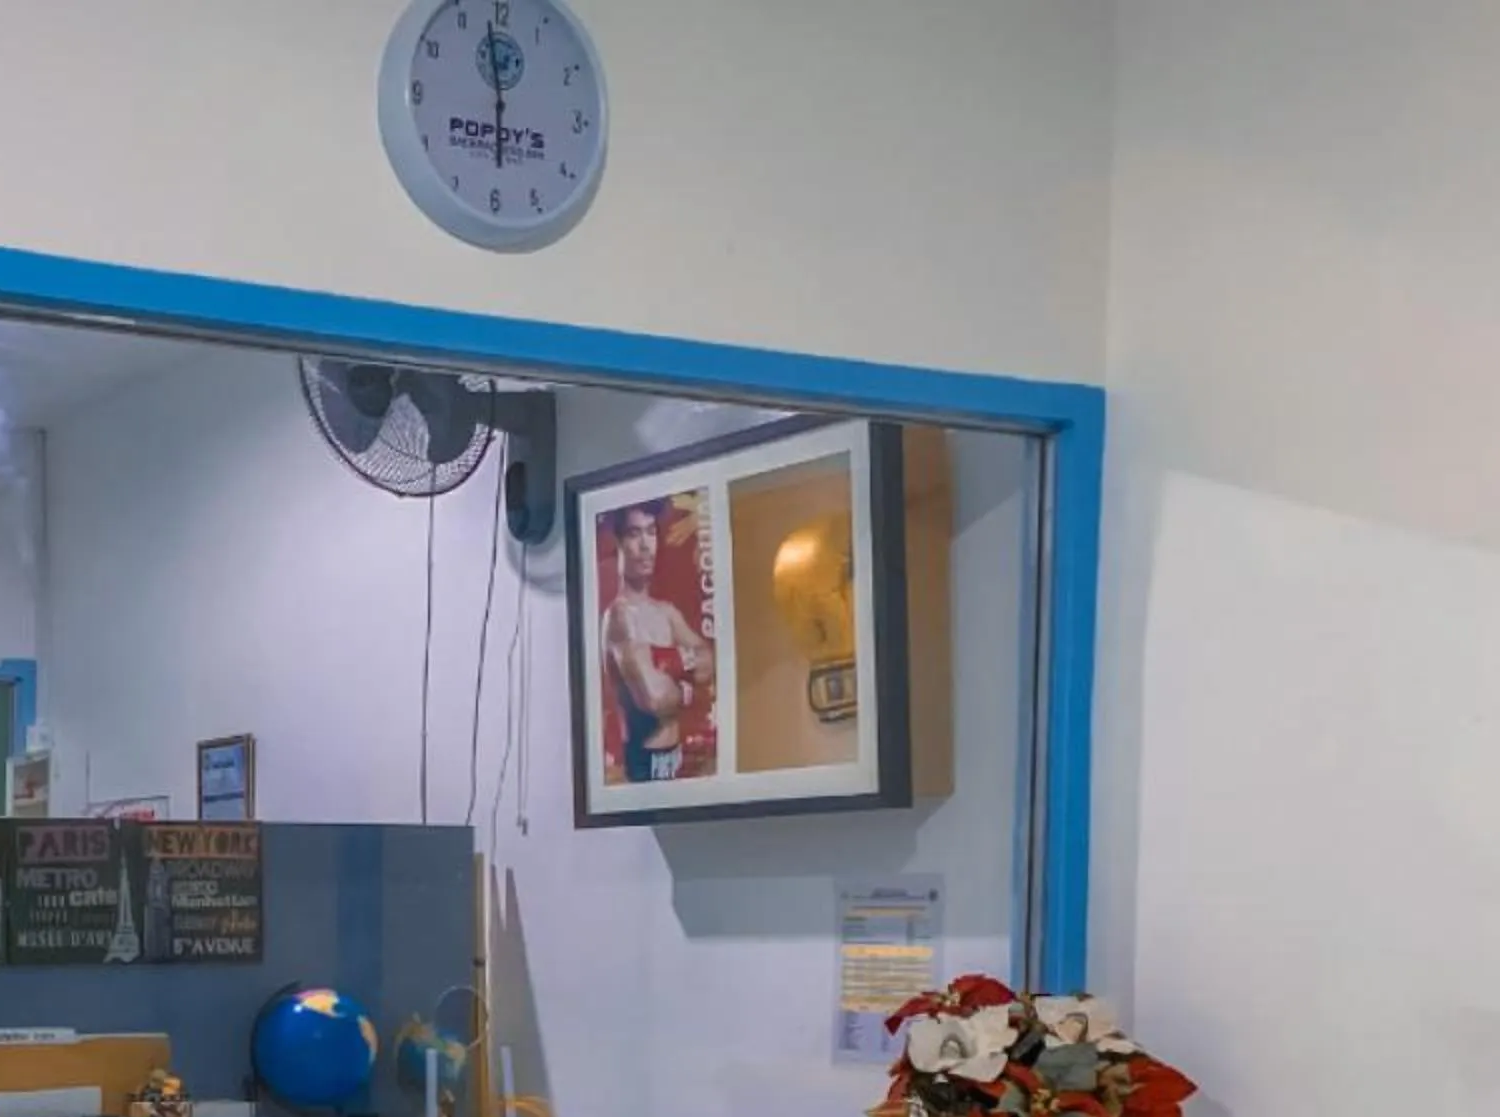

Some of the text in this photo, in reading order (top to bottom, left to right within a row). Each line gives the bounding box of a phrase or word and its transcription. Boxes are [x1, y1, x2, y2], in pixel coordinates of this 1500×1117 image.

[489, 188, 500, 214] 6
[19, 830, 106, 858] PARIS
[147, 830, 257, 855] NEW YORK
